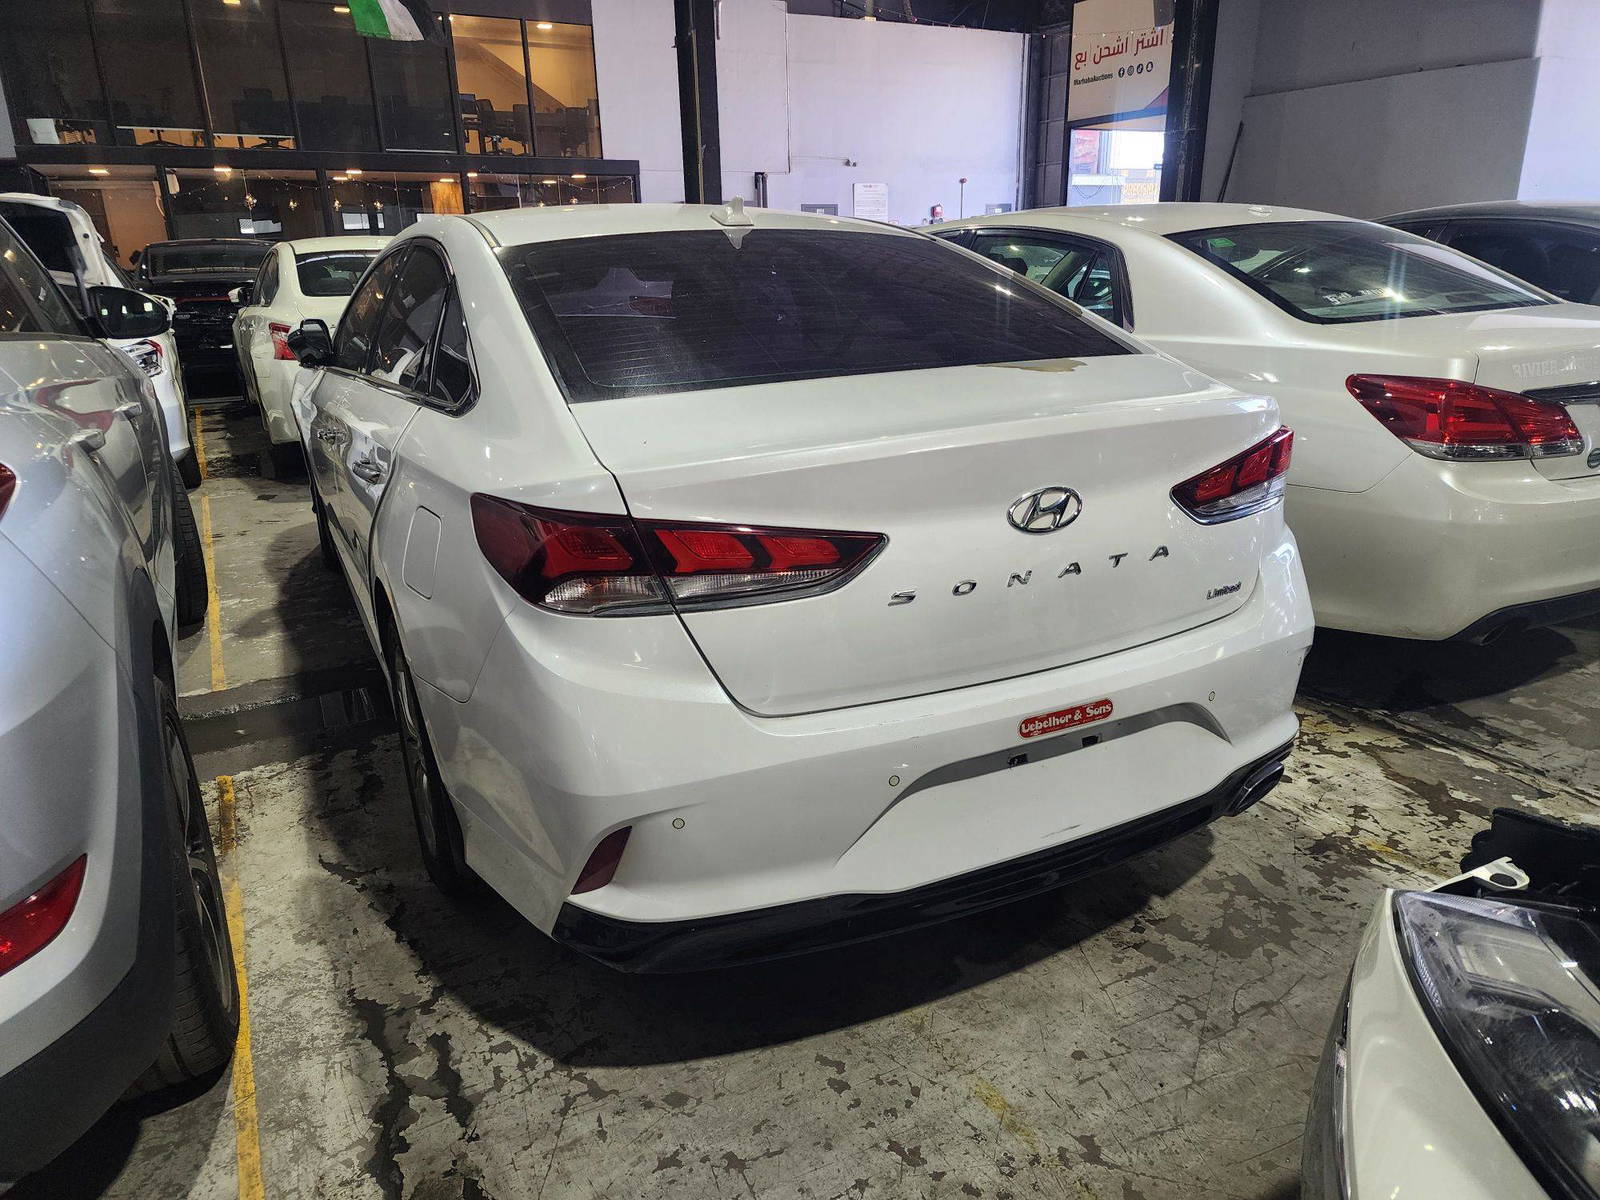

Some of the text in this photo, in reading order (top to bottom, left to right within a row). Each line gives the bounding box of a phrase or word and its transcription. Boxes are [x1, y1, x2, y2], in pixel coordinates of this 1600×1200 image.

[1074, 28, 1164, 70] اشتر اشحن بع
[888, 546, 1170, 607] SONATA
[1206, 581, 1242, 600] Limited
[1073, 709, 1082, 721] &
[1085, 703, 1112, 718] Sons
